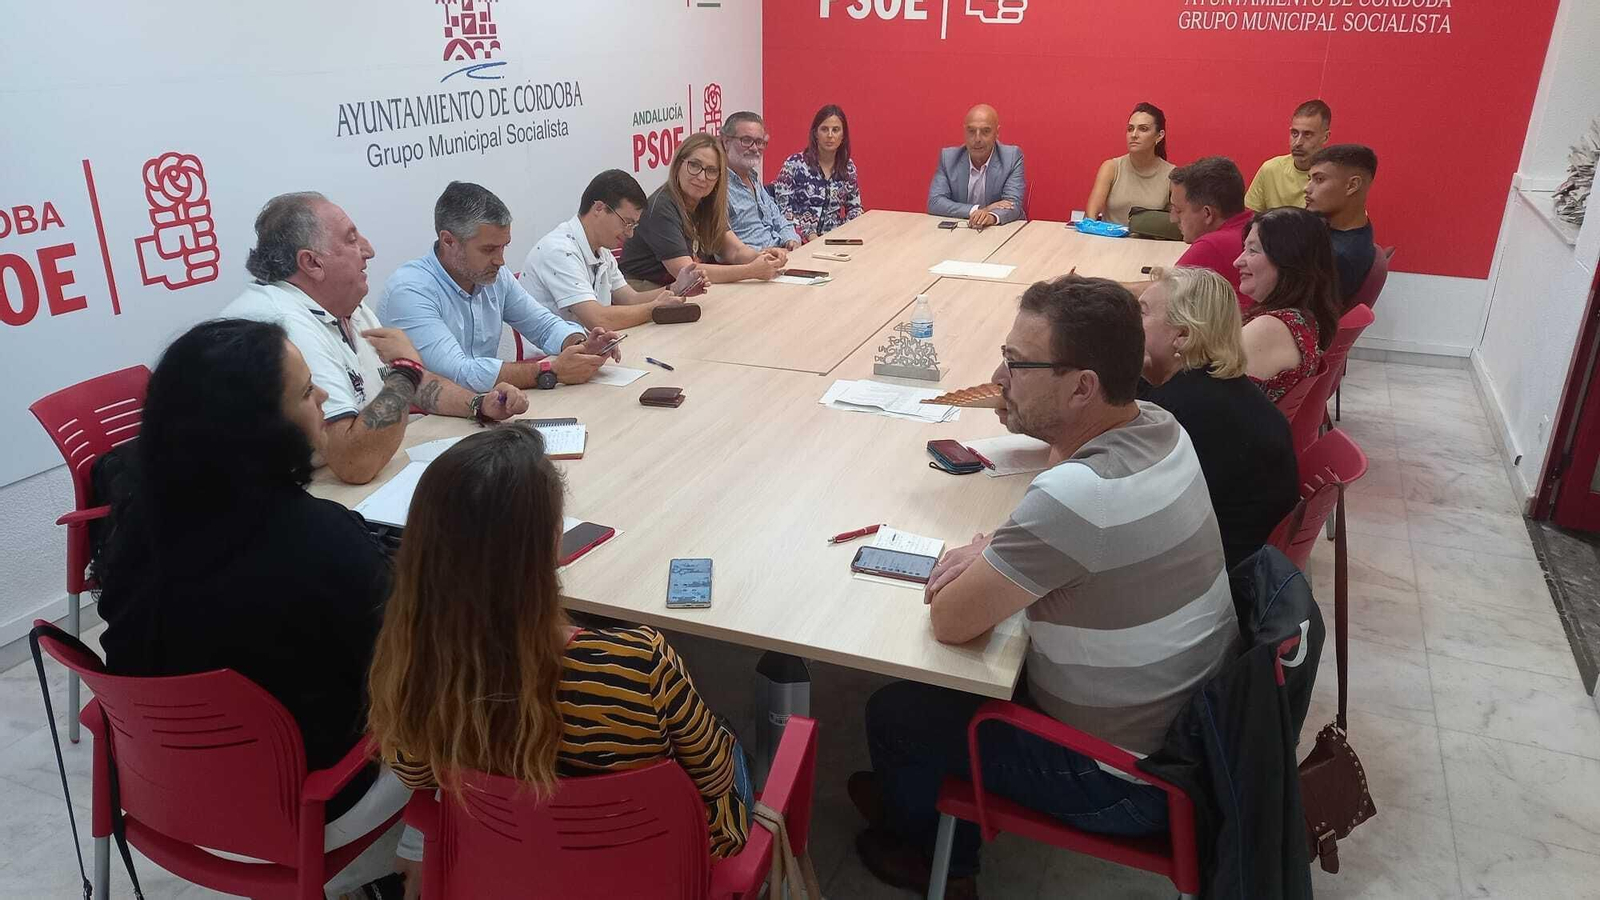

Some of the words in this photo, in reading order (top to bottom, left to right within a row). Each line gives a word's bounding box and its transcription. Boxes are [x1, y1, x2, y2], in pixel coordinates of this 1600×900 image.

[1178, 10, 1238, 31] GRUPO
[1241, 11, 1337, 31] MUNICIPAL
[1342, 12, 1452, 34] SOCIALISTA
[336, 89, 484, 137] AYUNTAMIENTO
[488, 87, 510, 117] DE
[513, 79, 583, 114] CÓRDOBA
[632, 102, 683, 127] ANDALUCÍA
[366, 142, 424, 168] Grupo
[428, 126, 502, 157] Municipal
[506, 118, 569, 145] Socialista
